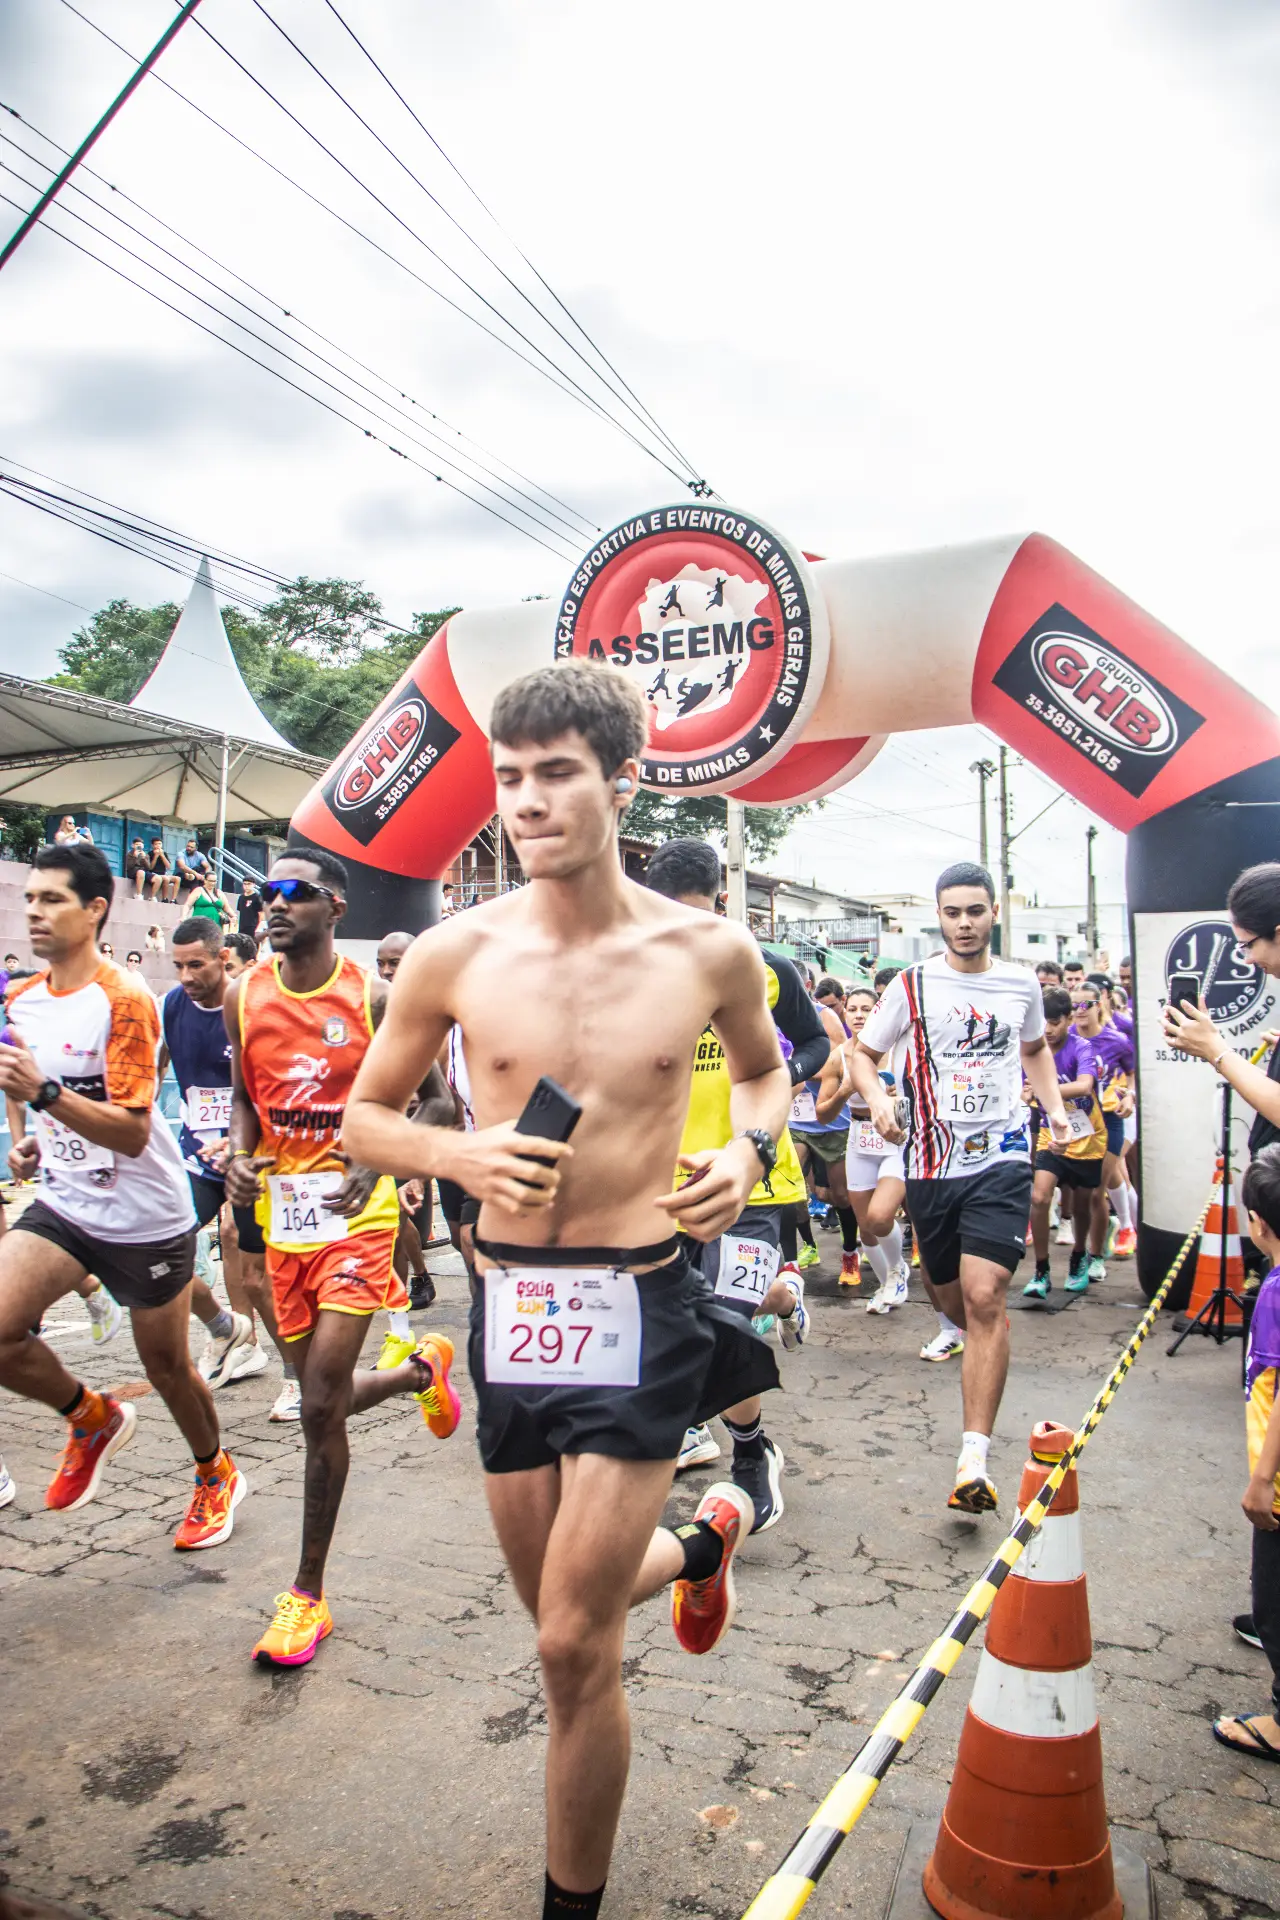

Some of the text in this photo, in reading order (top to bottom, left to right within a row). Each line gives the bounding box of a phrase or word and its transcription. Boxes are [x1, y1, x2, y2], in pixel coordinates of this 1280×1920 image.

[556, 510, 804, 708] AÇÃO ESPORTIVA E EVENTOS DE MINAS GERAIS
[588, 616, 775, 668] ASSEEMG
[1096, 655, 1142, 695] GRUPO
[1041, 644, 1162, 747] GHB
[357, 725, 386, 761] GRUPO
[1025, 693, 1122, 773] 35.3851.2165
[343, 710, 420, 802] GHB
[640, 746, 751, 783] L DE MINAS
[374, 743, 439, 820] 35.3851.2165
[1209, 985, 1256, 1019] FUSOS
[1228, 994, 1277, 1037] VAREJO
[692, 1062, 721, 1072] NNERS
[200, 1105, 233, 1122] 275
[950, 1094, 989, 1114] 167
[49, 1138, 87, 1161] 28
[859, 1136, 884, 1150] 348
[282, 1207, 320, 1231] 164
[730, 1265, 767, 1296] 211
[508, 1323, 593, 1364] 297
